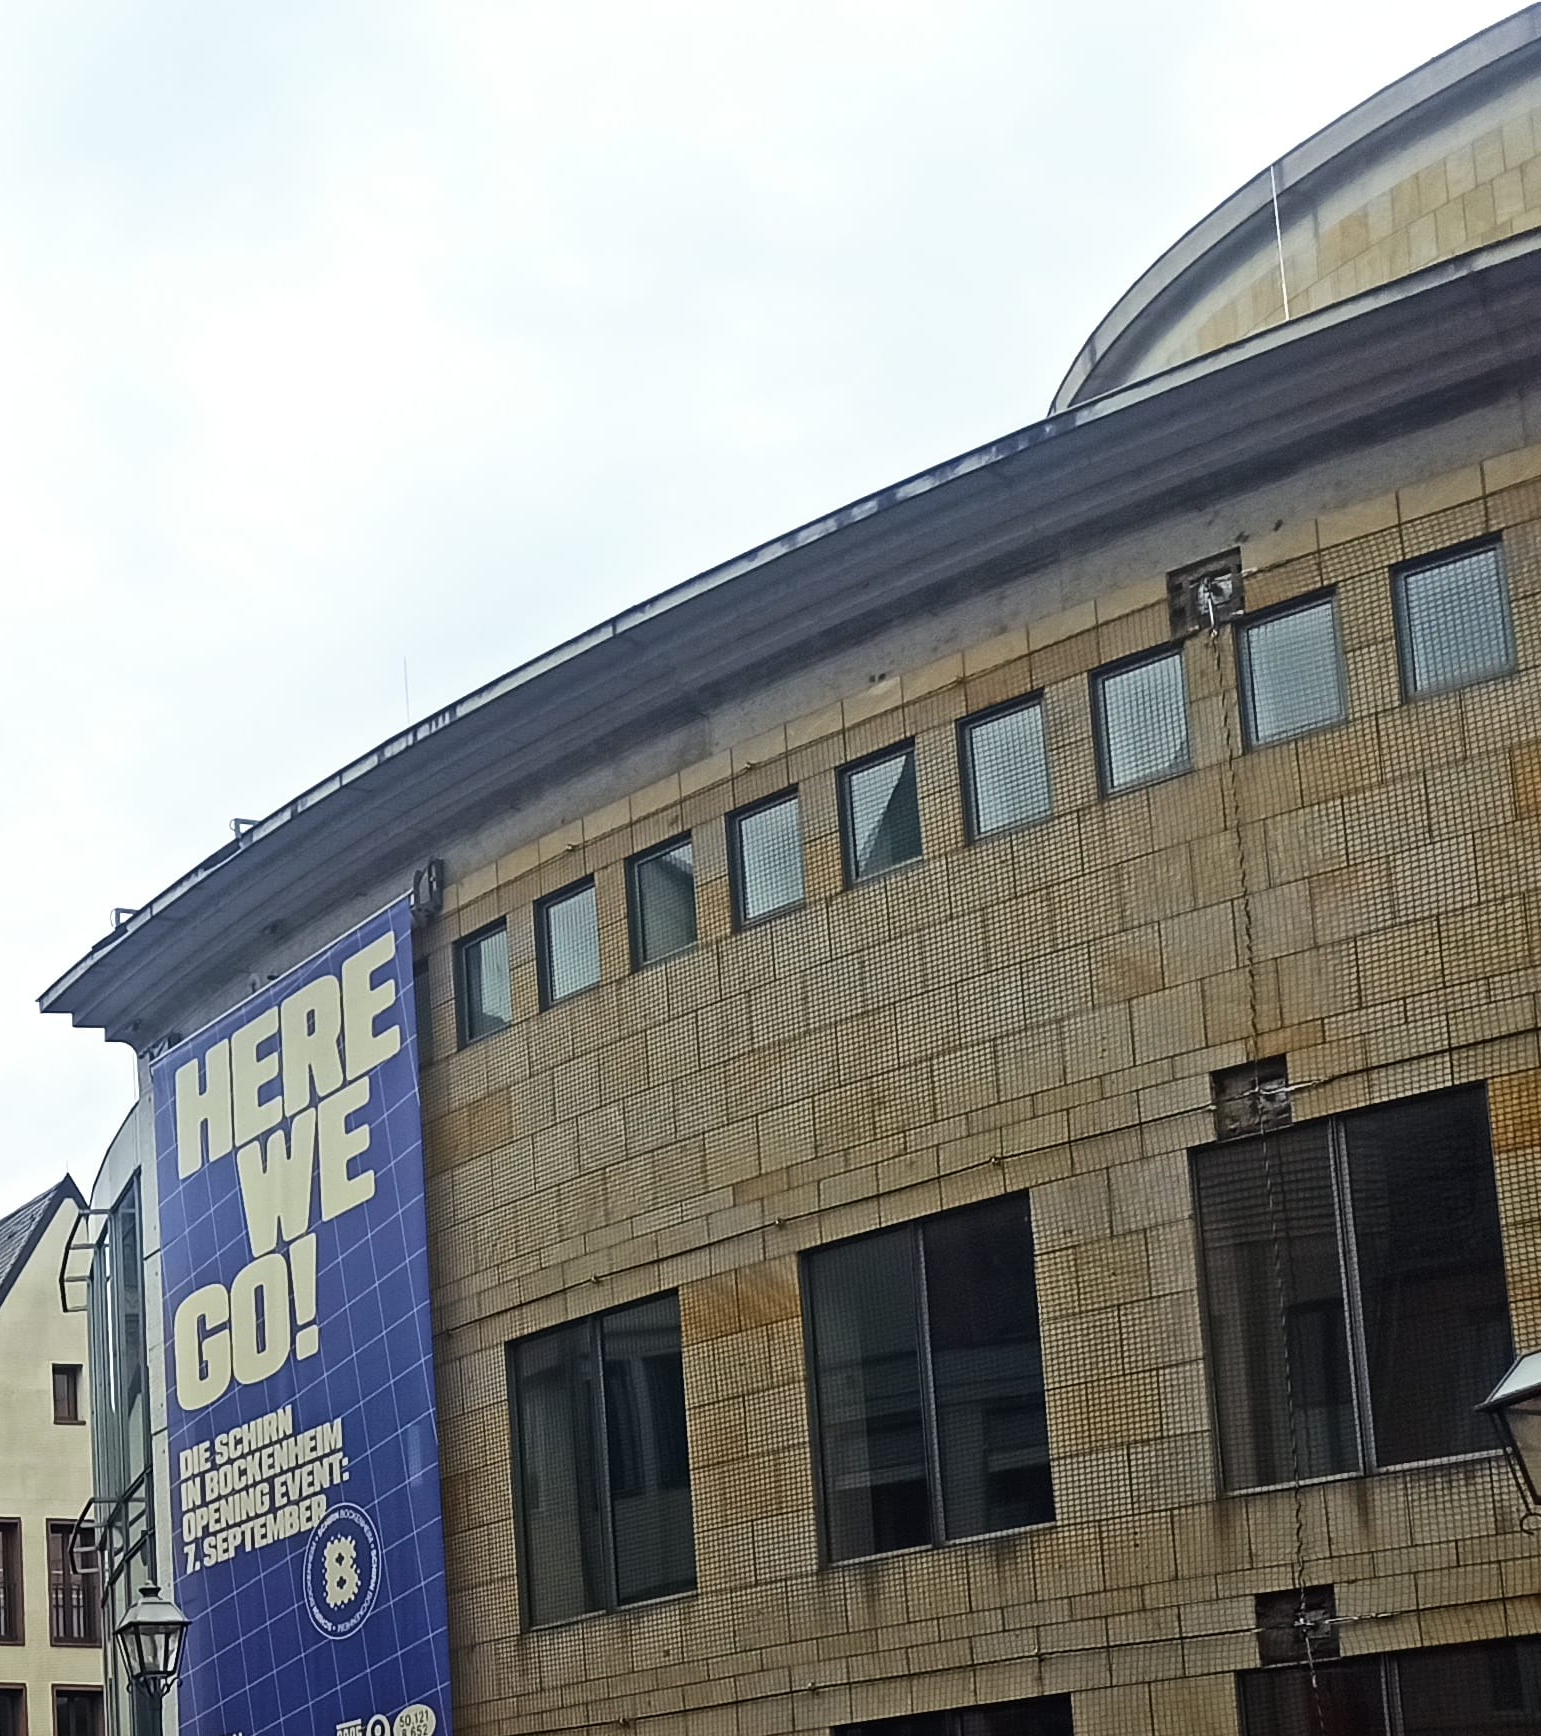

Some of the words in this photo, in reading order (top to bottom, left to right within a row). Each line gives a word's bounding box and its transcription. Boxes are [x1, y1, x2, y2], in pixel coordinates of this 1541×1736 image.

[174, 930, 401, 1180] HERE
[236, 1076, 376, 1259] WE
[173, 1233, 320, 1411] GO!
[179, 1440, 211, 1480] DIE
[215, 1404, 293, 1465] SCHIRN
[181, 1479, 202, 1512] IN
[205, 1417, 343, 1502] BOCKENHEIM
[182, 1482, 270, 1543] OPENING
[275, 1452, 350, 1507] EVENT:
[183, 1543, 201, 1575] 7.
[204, 1494, 328, 1567] SEPTEMBER
[399, 1709, 429, 1728] 50.121
